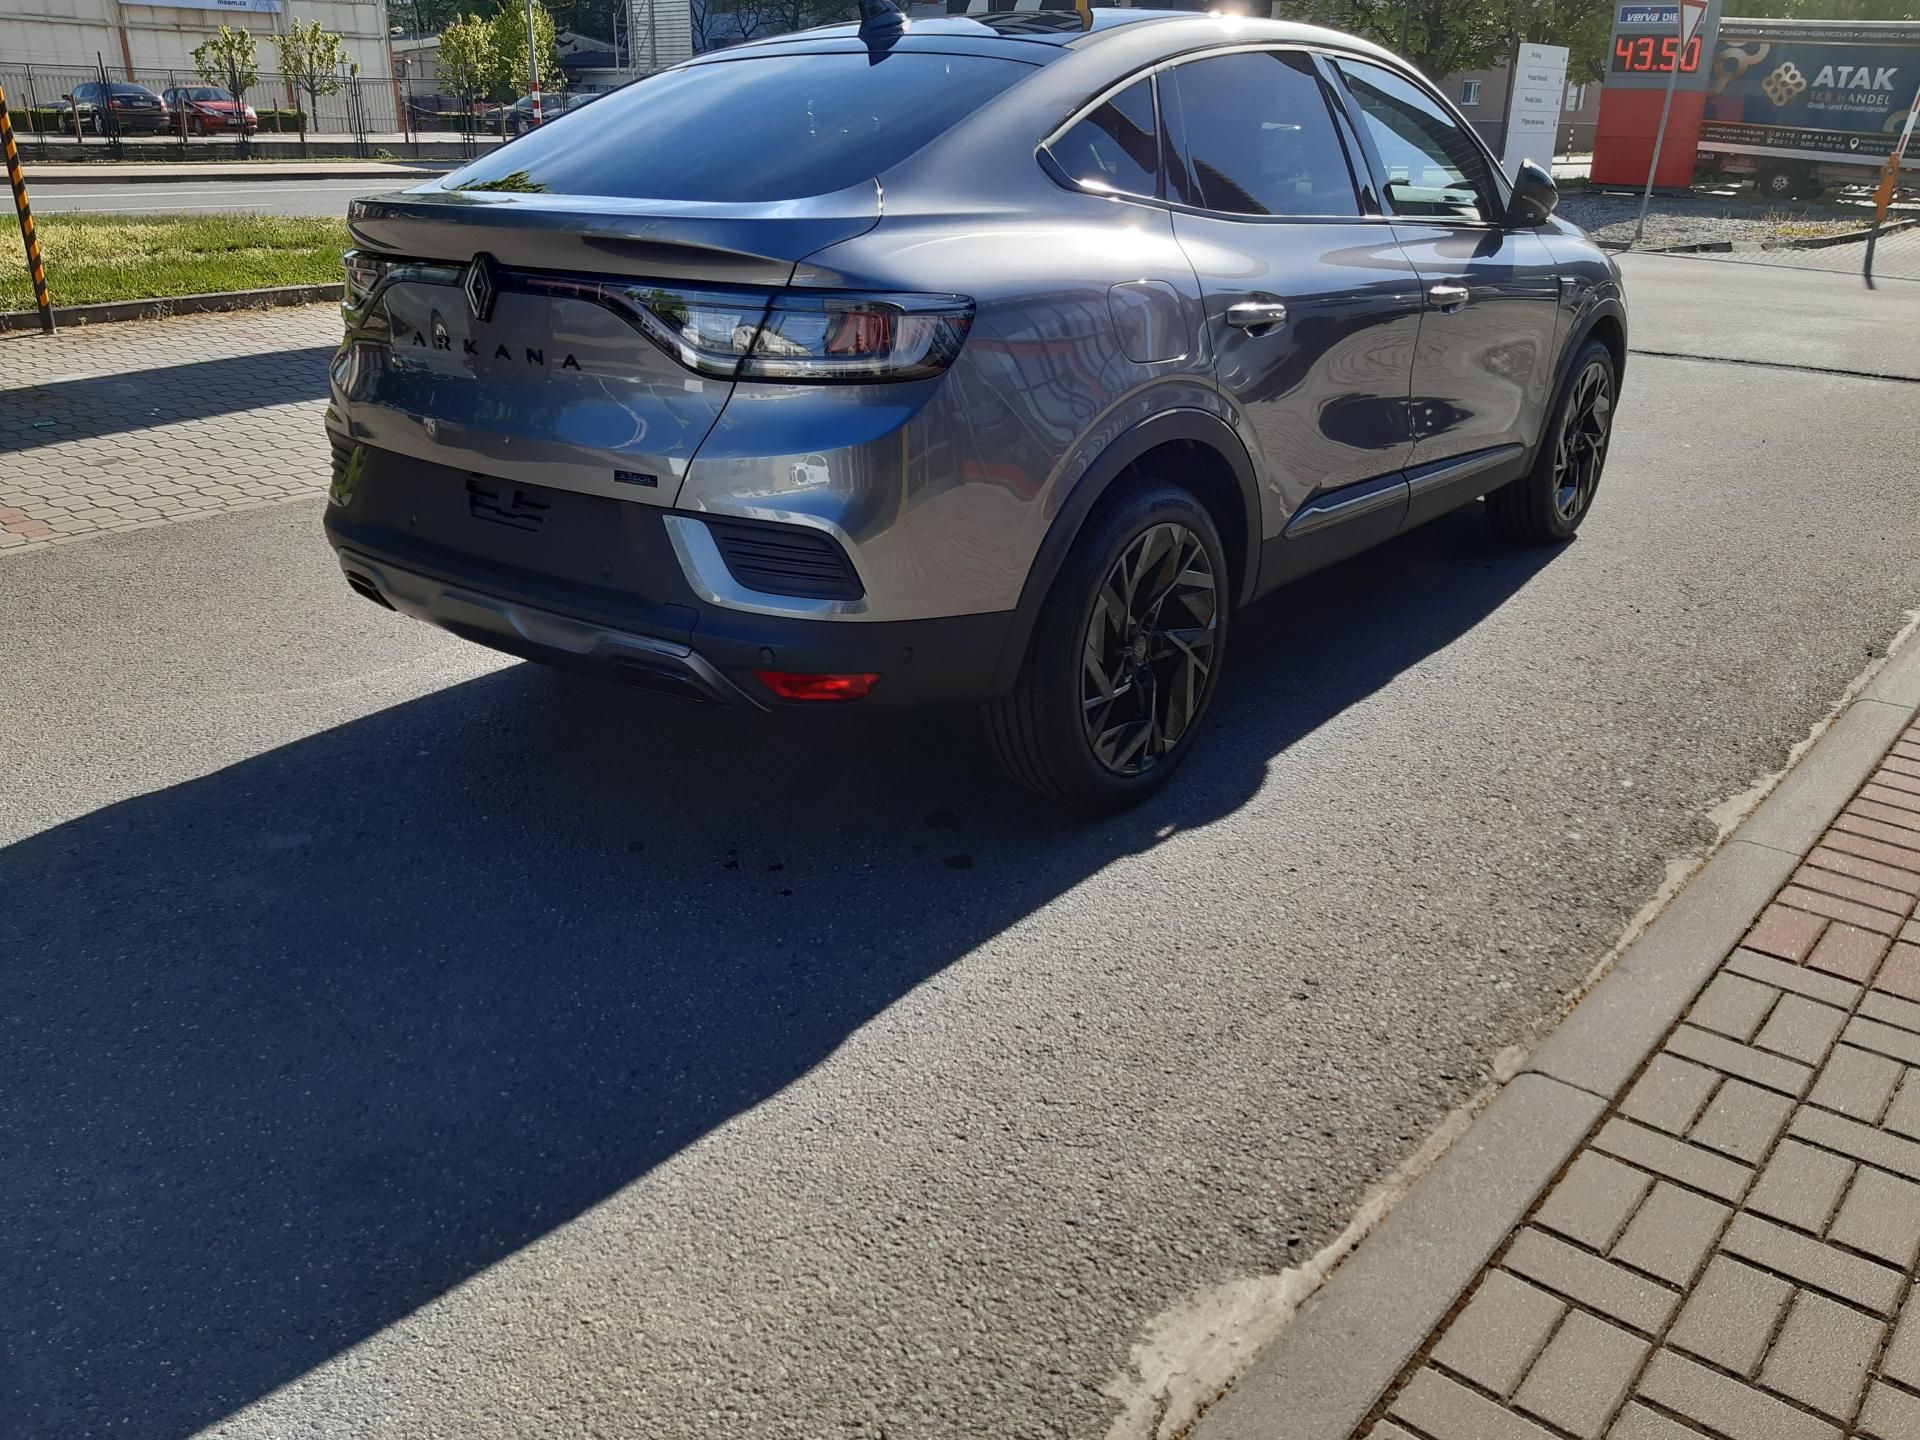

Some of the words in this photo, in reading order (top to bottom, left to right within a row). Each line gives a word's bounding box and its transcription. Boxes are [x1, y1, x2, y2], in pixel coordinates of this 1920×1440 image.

[1627, 13, 1660, 21] verva
[1662, 13, 1680, 22] DIE
[1616, 36, 1702, 71] 43.50
[1812, 65, 1898, 91] ATAK
[1838, 93, 1890, 105] HANDEL
[412, 331, 582, 371] ARKANA
